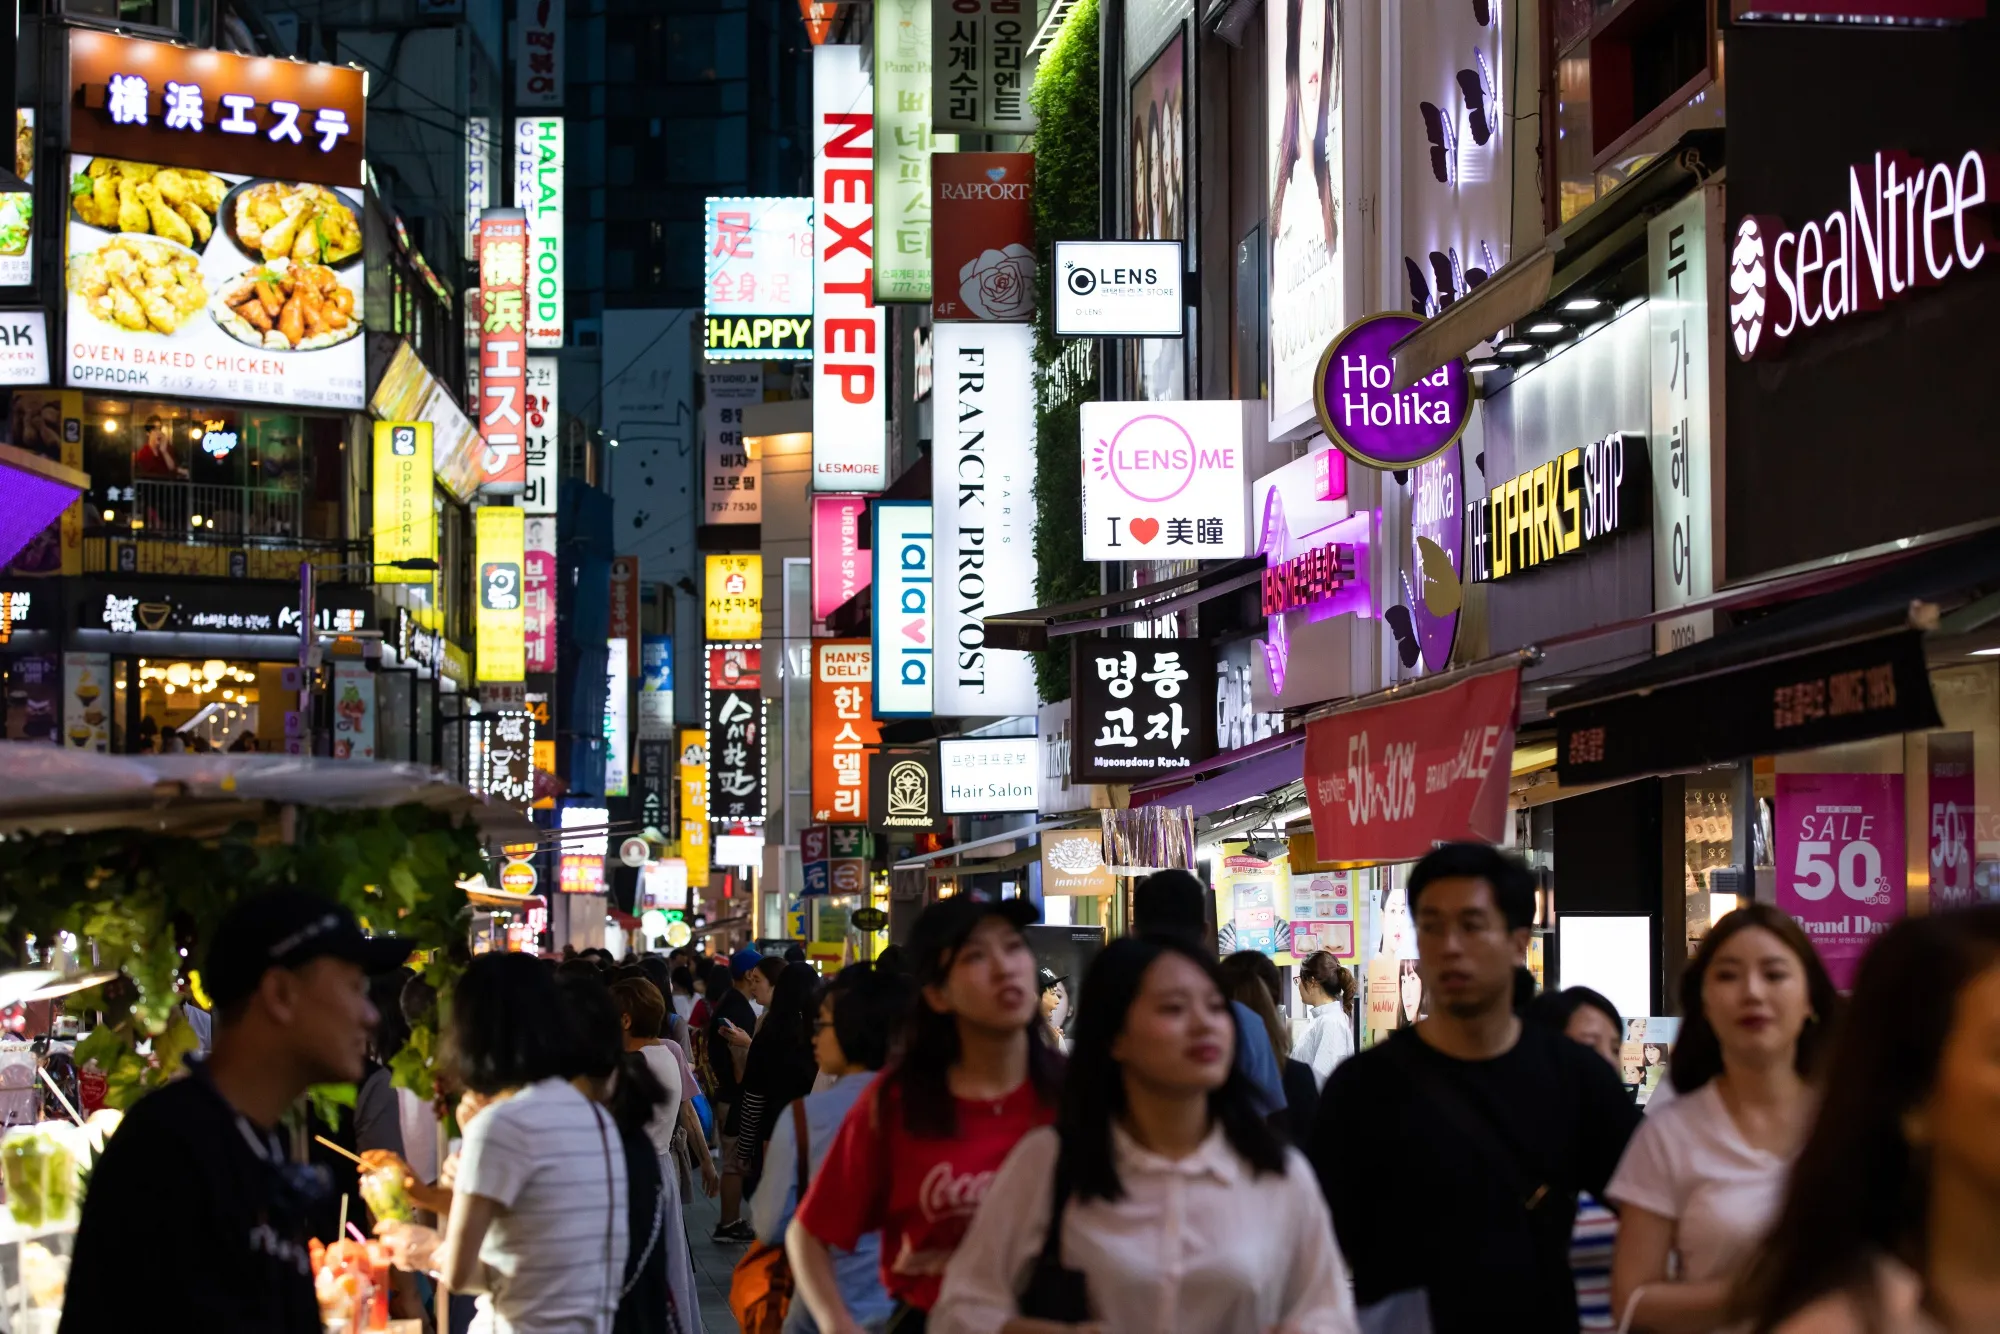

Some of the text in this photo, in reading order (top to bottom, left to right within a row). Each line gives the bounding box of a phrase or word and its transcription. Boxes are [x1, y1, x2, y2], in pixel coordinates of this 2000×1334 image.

[884, 61, 914, 74] Pane
[947, 20, 978, 122] 시계수리
[993, 20, 1022, 121] 오리엔트
[108, 74, 350, 152] 横浜エステ
[941, 183, 1029, 200] RAPPORT
[538, 122, 557, 322] HALAL FOOD
[712, 212, 754, 260] 足
[823, 113, 877, 404] NEXTEP
[1147, 288, 1174, 296] STORE
[937, 303, 955, 314] 4F
[709, 318, 812, 348] HAPPY
[73, 343, 285, 376] OVEN BAKED CHICKEN
[483, 242, 525, 475] 横浜エステ
[1341, 354, 1450, 389] Hoka
[72, 365, 149, 385] OPPADAK
[1343, 392, 1451, 426] Holika
[818, 463, 880, 475] LESMORE
[1117, 448, 1234, 470] LENS ME
[712, 476, 755, 491] 프로필
[402, 460, 412, 547] OPPADAK
[1003, 475, 1011, 544] PARIS
[1467, 497, 1489, 584] THE
[1584, 431, 1624, 541] SHOP
[841, 506, 855, 556] URBAN
[958, 347, 985, 695] FRANCK PROVOST
[1107, 516, 1224, 546] I 美瞳
[825, 651, 870, 663] HAN'S
[1094, 650, 1190, 699] 명동
[1094, 702, 1190, 750] 교자
[832, 685, 864, 818] 한스델리
[1093, 756, 1155, 768] Myeongdong
[951, 783, 1033, 799] Hair Salon
[728, 805, 745, 818] 2F
[816, 810, 831, 821] 4F
[883, 815, 934, 827] Mamonde
[1800, 815, 1875, 841] SALE
[1054, 876, 1105, 888] innisfree
[1792, 840, 1882, 901] 50
[1864, 893, 1890, 905] up to
